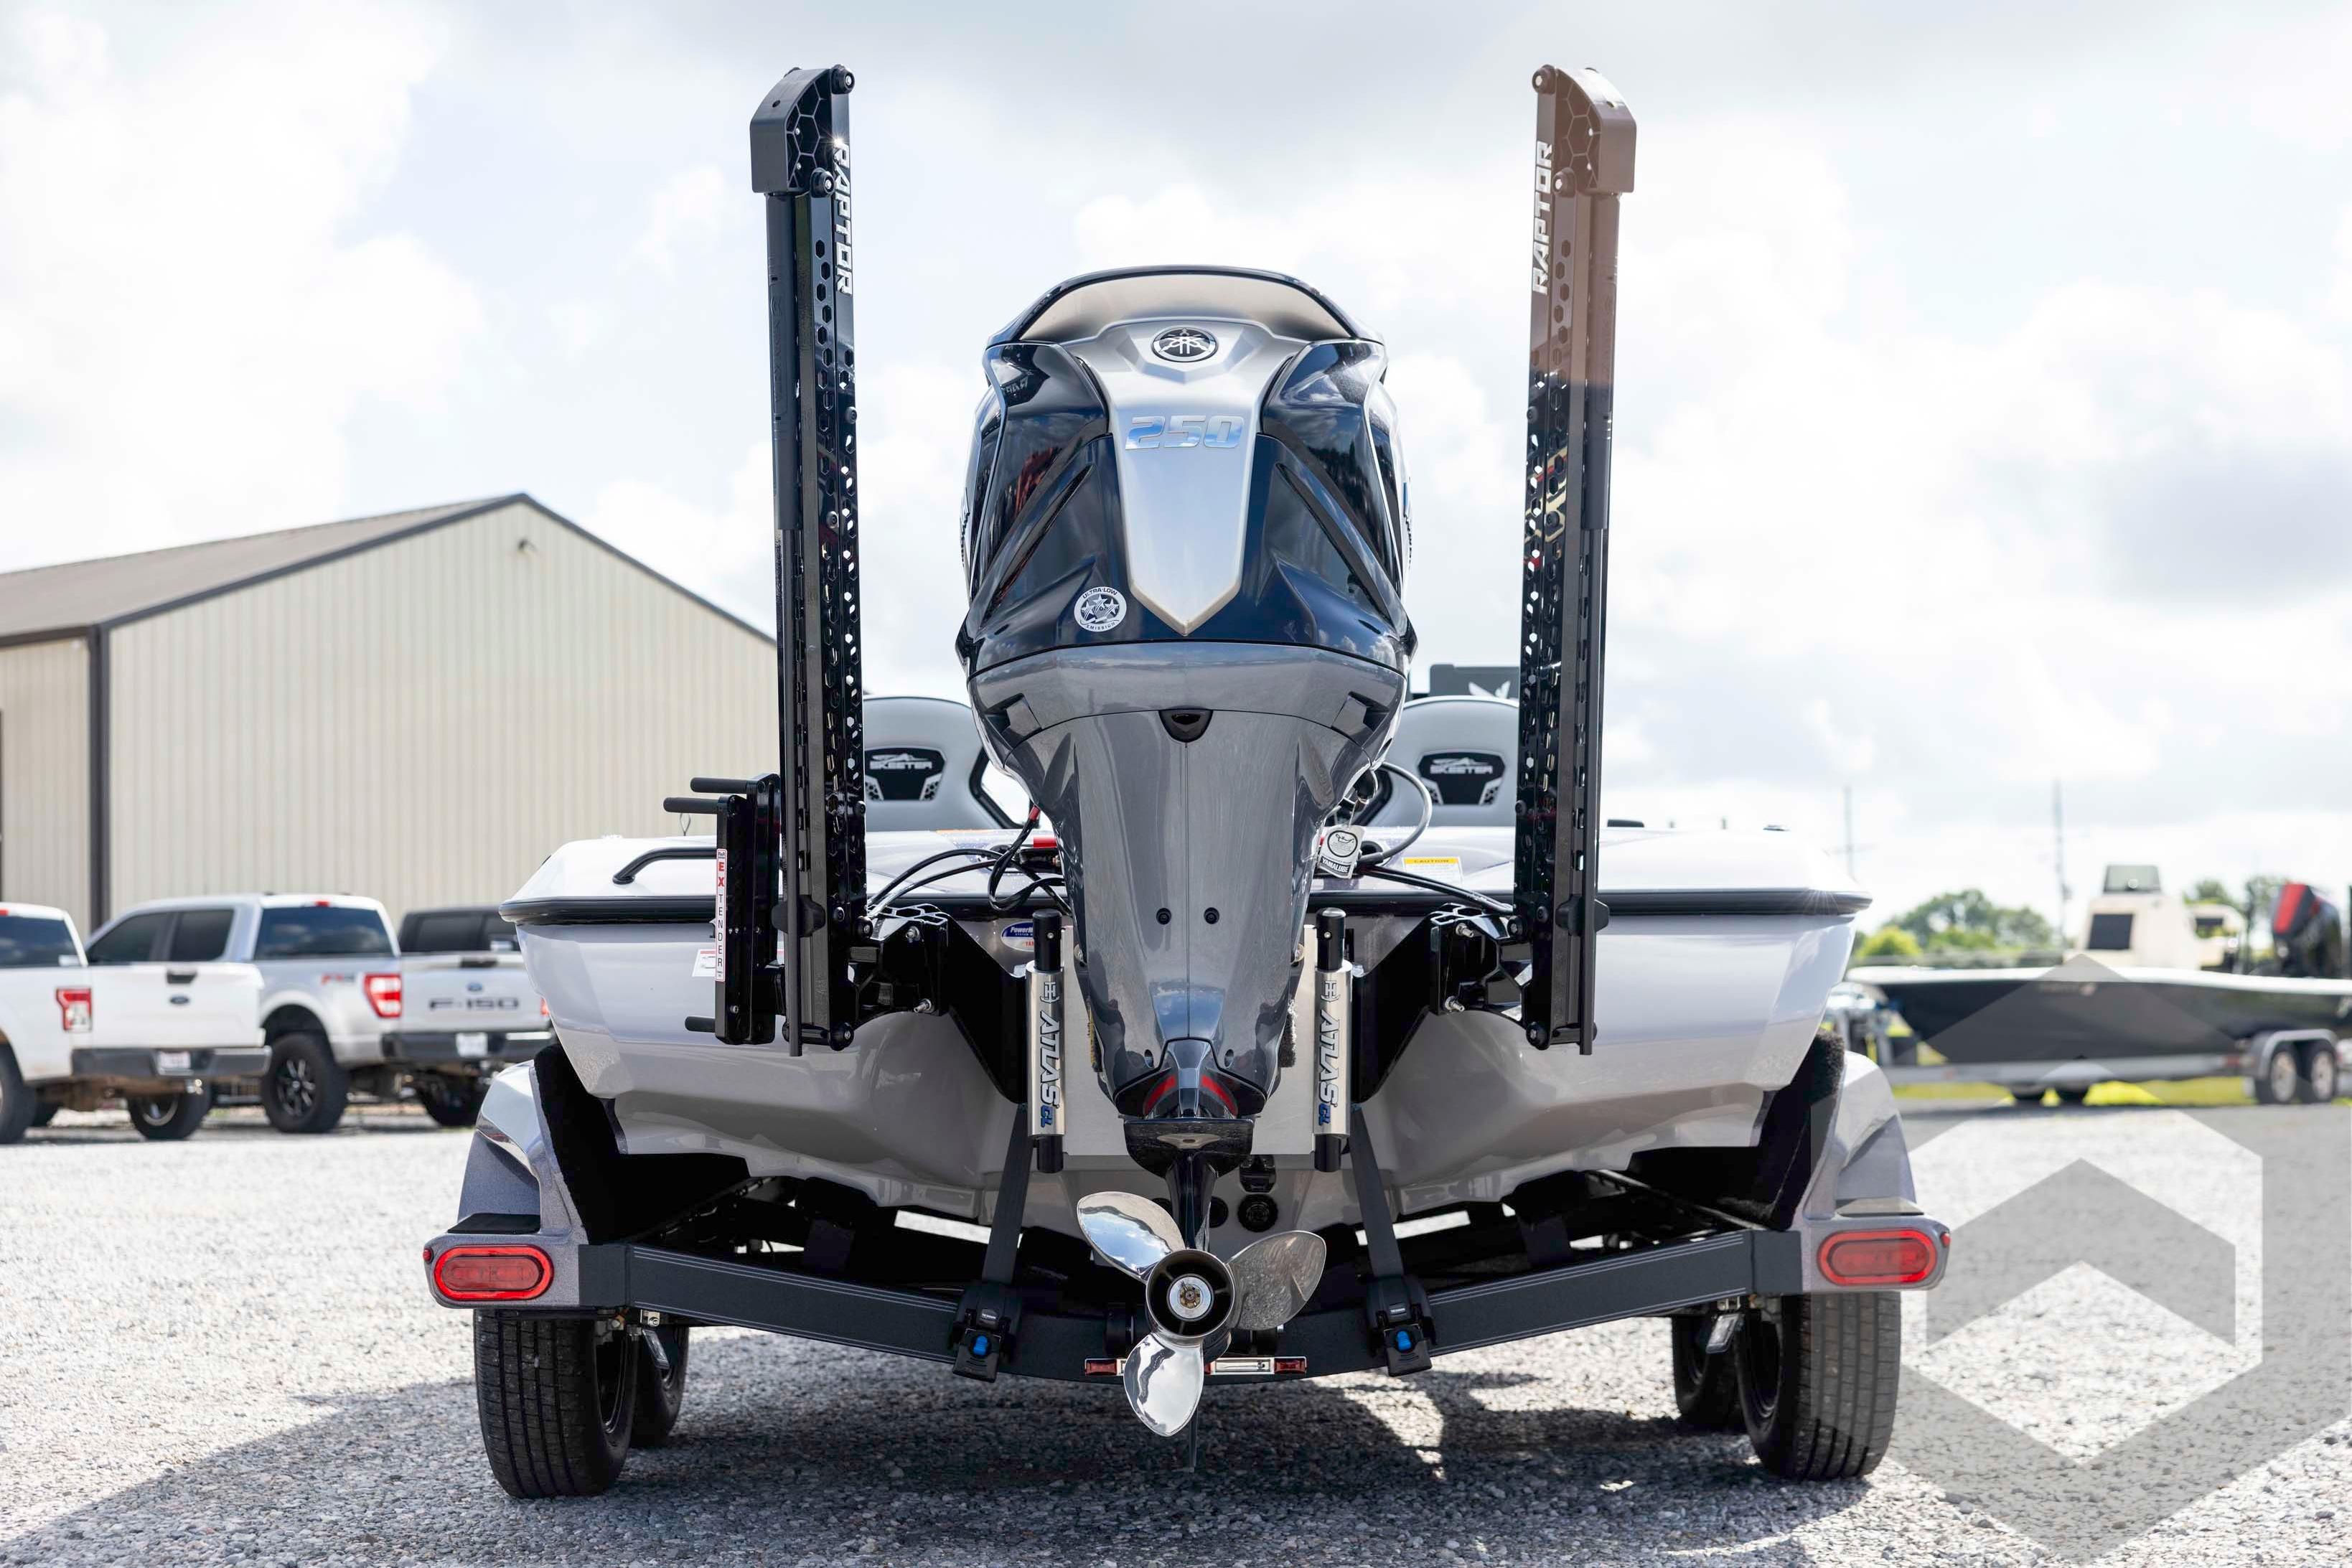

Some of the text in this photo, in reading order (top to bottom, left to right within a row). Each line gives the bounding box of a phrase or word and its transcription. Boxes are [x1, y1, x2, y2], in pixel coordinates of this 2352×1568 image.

[833, 142, 853, 295] RAPTOR
[1532, 141, 1552, 295] RAPTOR
[1125, 415, 1245, 451] 250
[1322, 858, 1349, 873] YAMALUBE
[428, 997, 519, 1010] F-150
[1041, 1010, 1061, 1105] ATLAS
[1319, 1009, 1340, 1104] ATLAS
